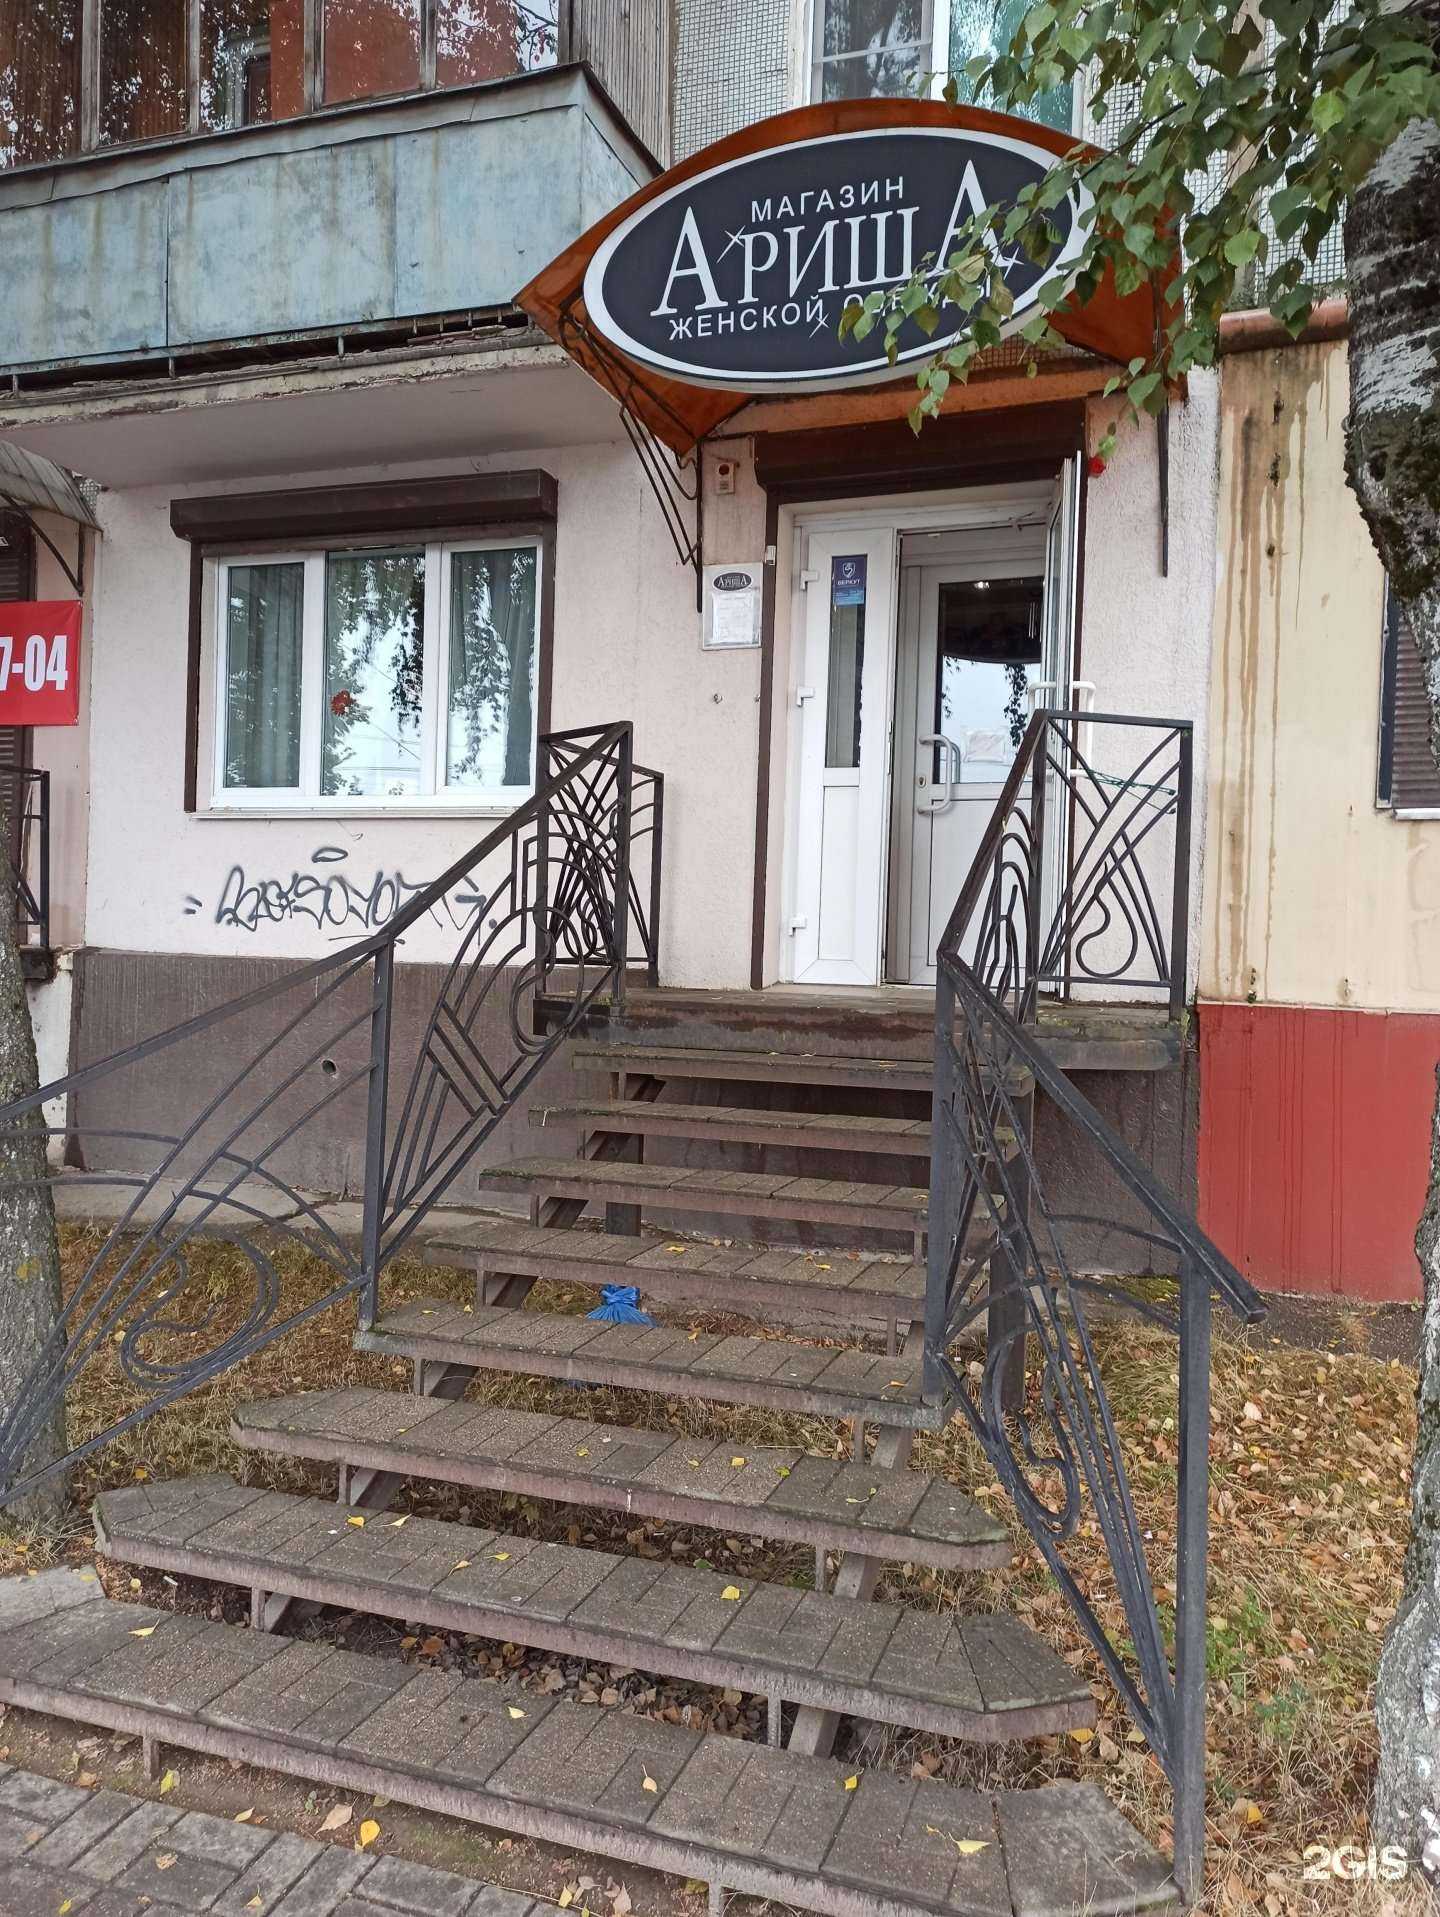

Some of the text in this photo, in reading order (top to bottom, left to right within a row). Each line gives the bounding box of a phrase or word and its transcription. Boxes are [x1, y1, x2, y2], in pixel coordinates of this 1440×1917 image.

[752, 175, 904, 222] МАГАЗИН
[650, 159, 1010, 316] АРИША
[669, 295, 825, 340] ЖЕНСКОЙ
